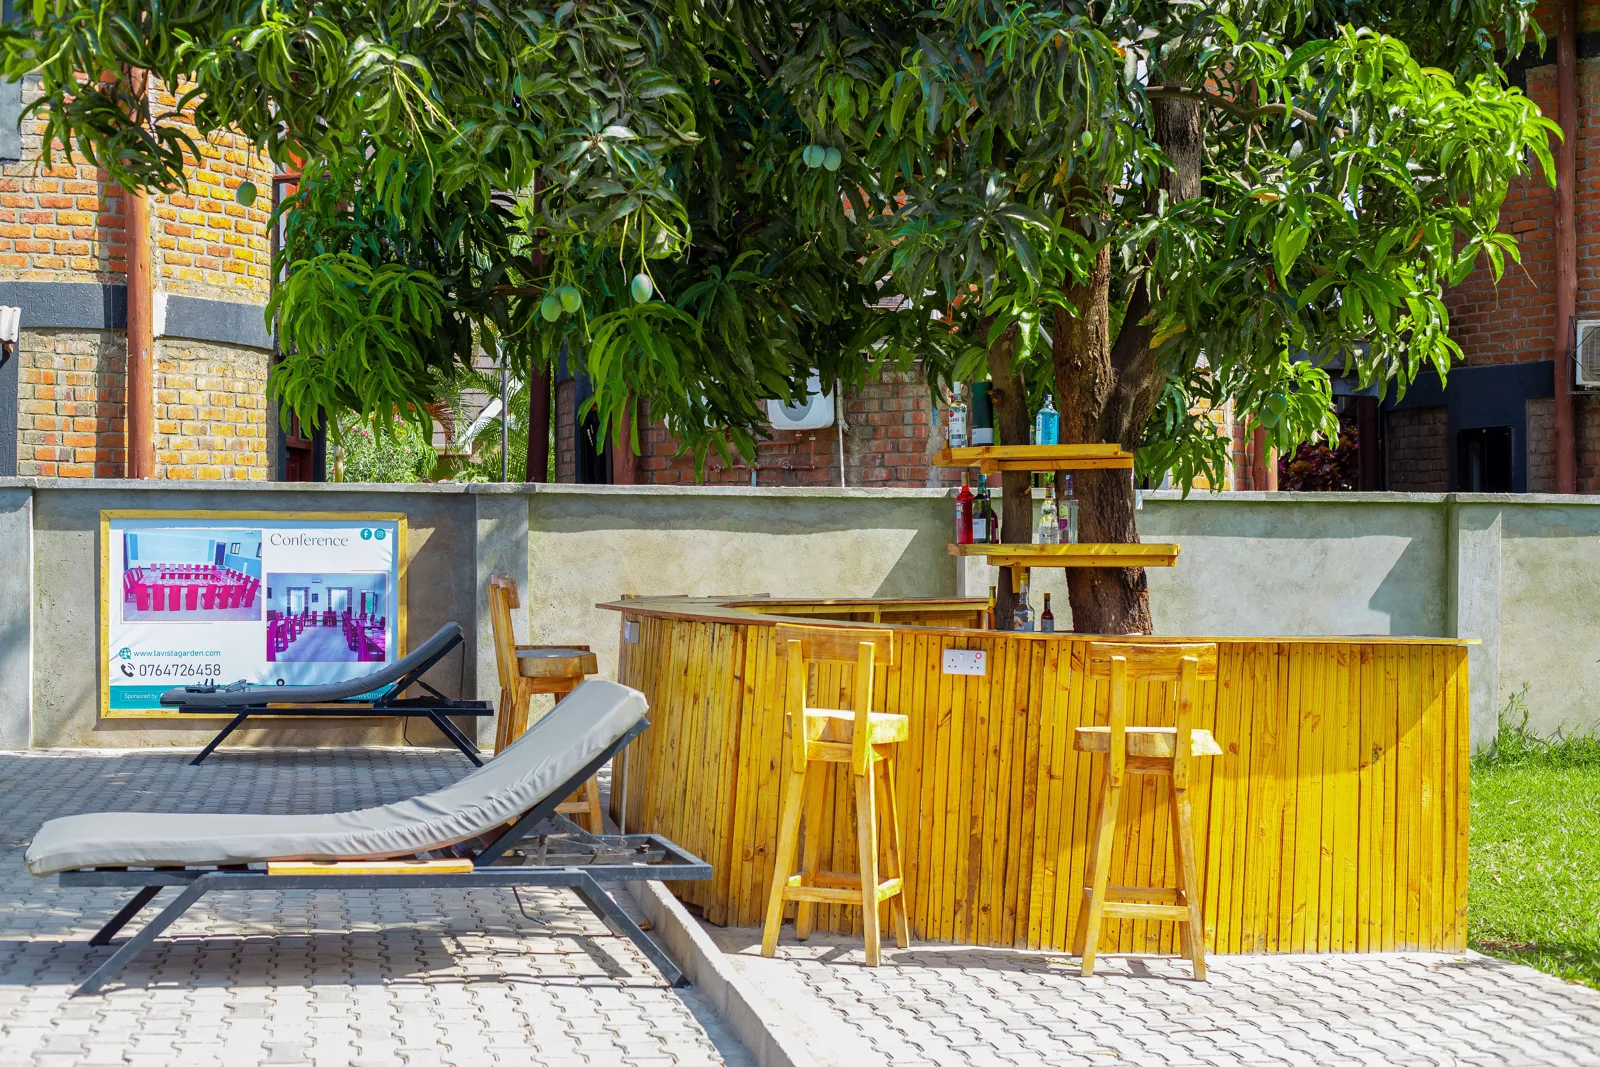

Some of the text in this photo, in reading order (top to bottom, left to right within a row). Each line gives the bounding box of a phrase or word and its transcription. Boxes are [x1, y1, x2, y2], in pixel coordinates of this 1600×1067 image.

[270, 533, 349, 546] Conference
[133, 649, 221, 658] www.lavistagarden.com
[139, 664, 221, 676] 0764726458
[124, 692, 158, 700] Sponsored by
